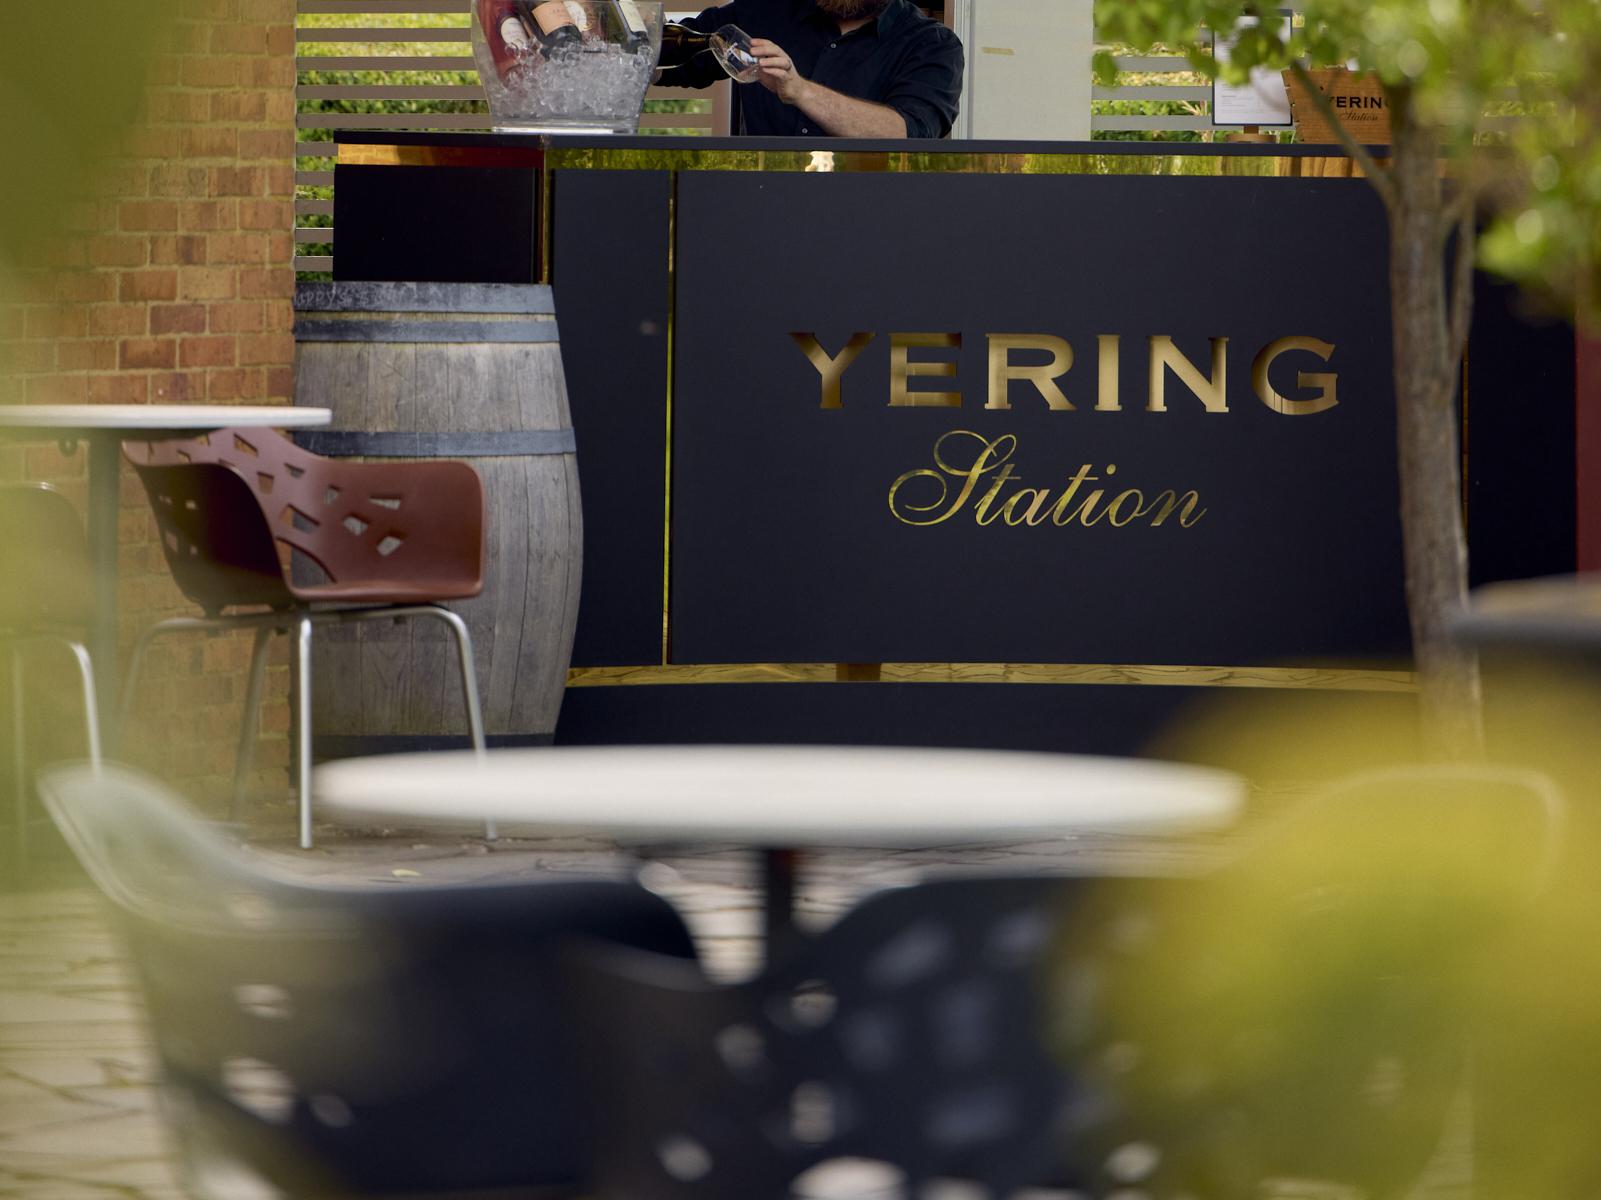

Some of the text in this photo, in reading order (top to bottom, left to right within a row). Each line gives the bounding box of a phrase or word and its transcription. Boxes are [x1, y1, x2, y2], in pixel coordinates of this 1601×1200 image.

[1329, 96, 1390, 108] ERIN
[789, 332, 1340, 416] YERING
[888, 430, 1208, 528] Station
